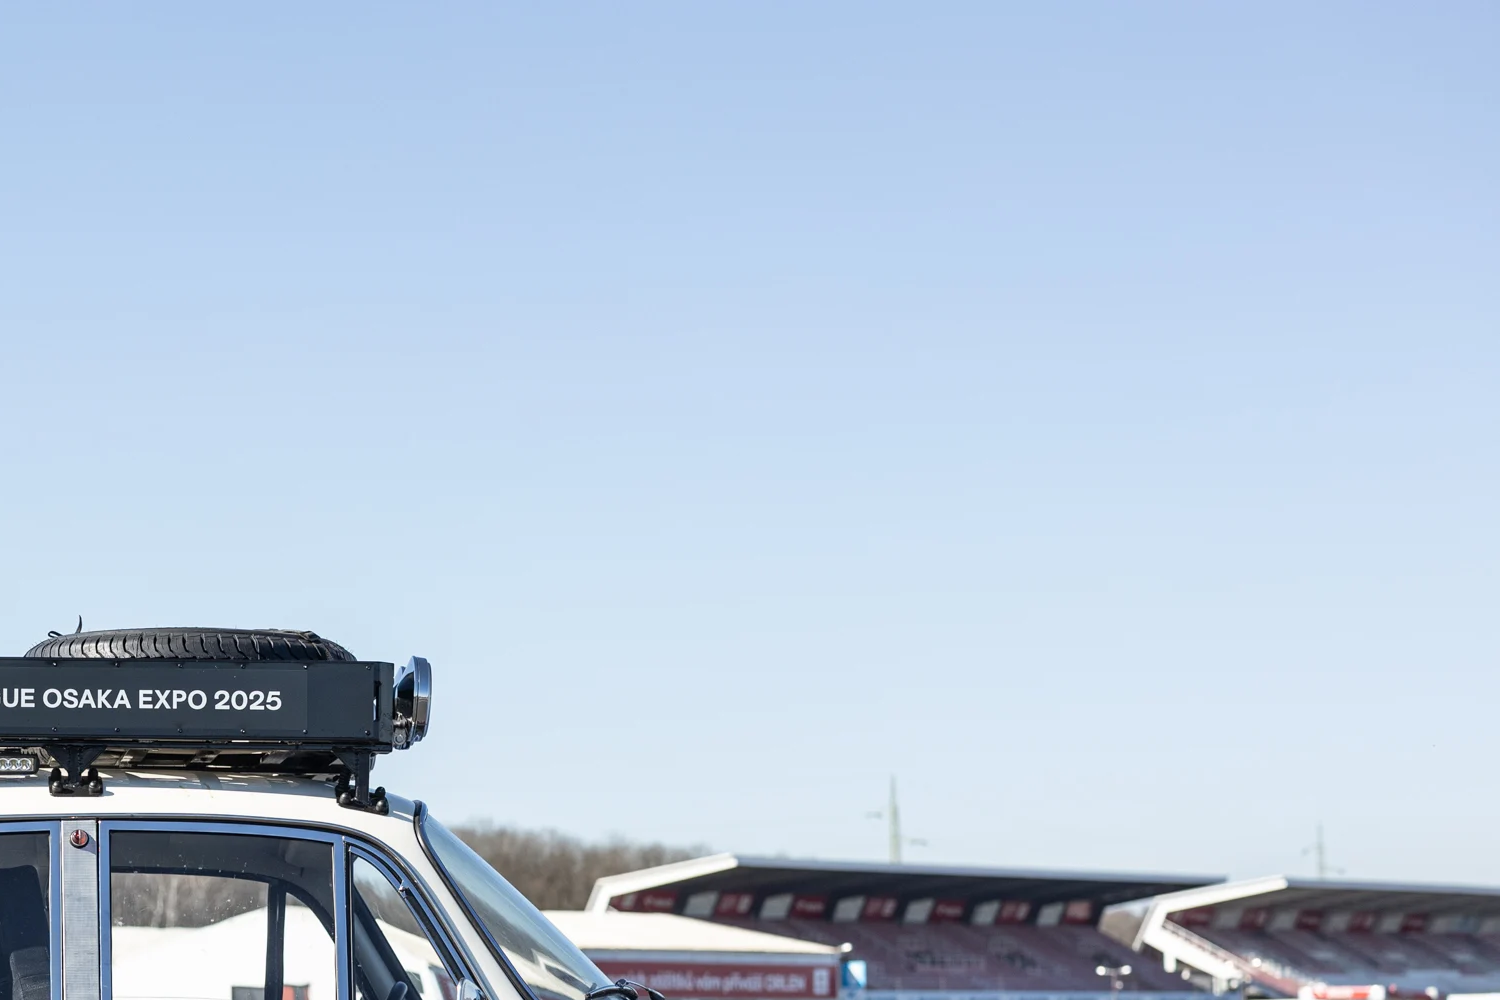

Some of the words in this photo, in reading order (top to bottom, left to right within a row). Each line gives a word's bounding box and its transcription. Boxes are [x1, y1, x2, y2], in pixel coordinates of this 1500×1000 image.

[42, 688, 132, 709] OSAKA
[139, 689, 208, 710] EXPO
[214, 690, 283, 711] 2025
